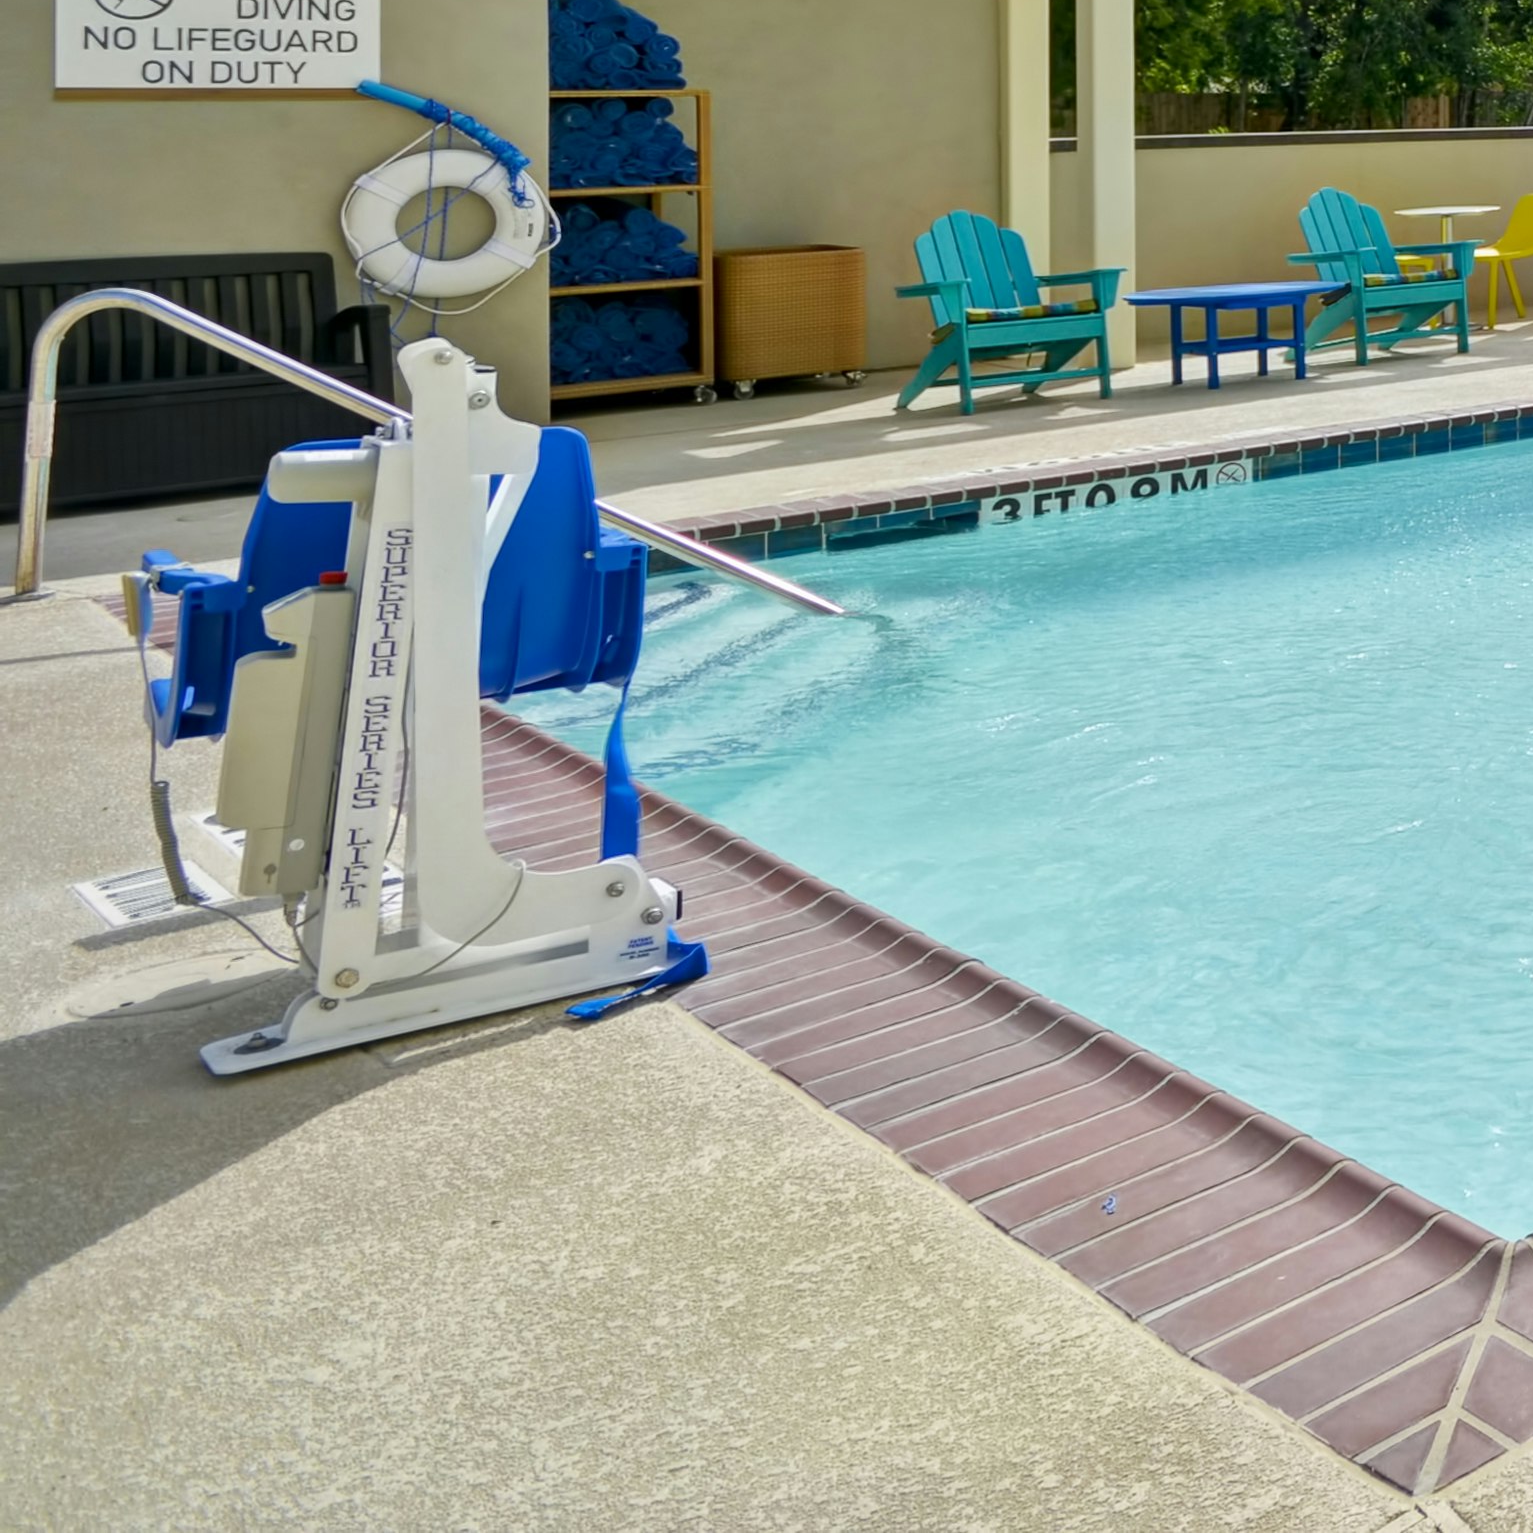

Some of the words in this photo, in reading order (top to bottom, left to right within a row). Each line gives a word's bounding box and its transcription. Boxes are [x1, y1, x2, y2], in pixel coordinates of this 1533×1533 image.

[83, 25, 136, 50] NO
[153, 27, 358, 53] LIFEGUARD
[141, 60, 193, 84] ON
[210, 61, 306, 84] DUTY
[368, 528, 414, 678] SUPERIOR
[351, 695, 392, 809] SERIES
[340, 826, 373, 904] LIFT
